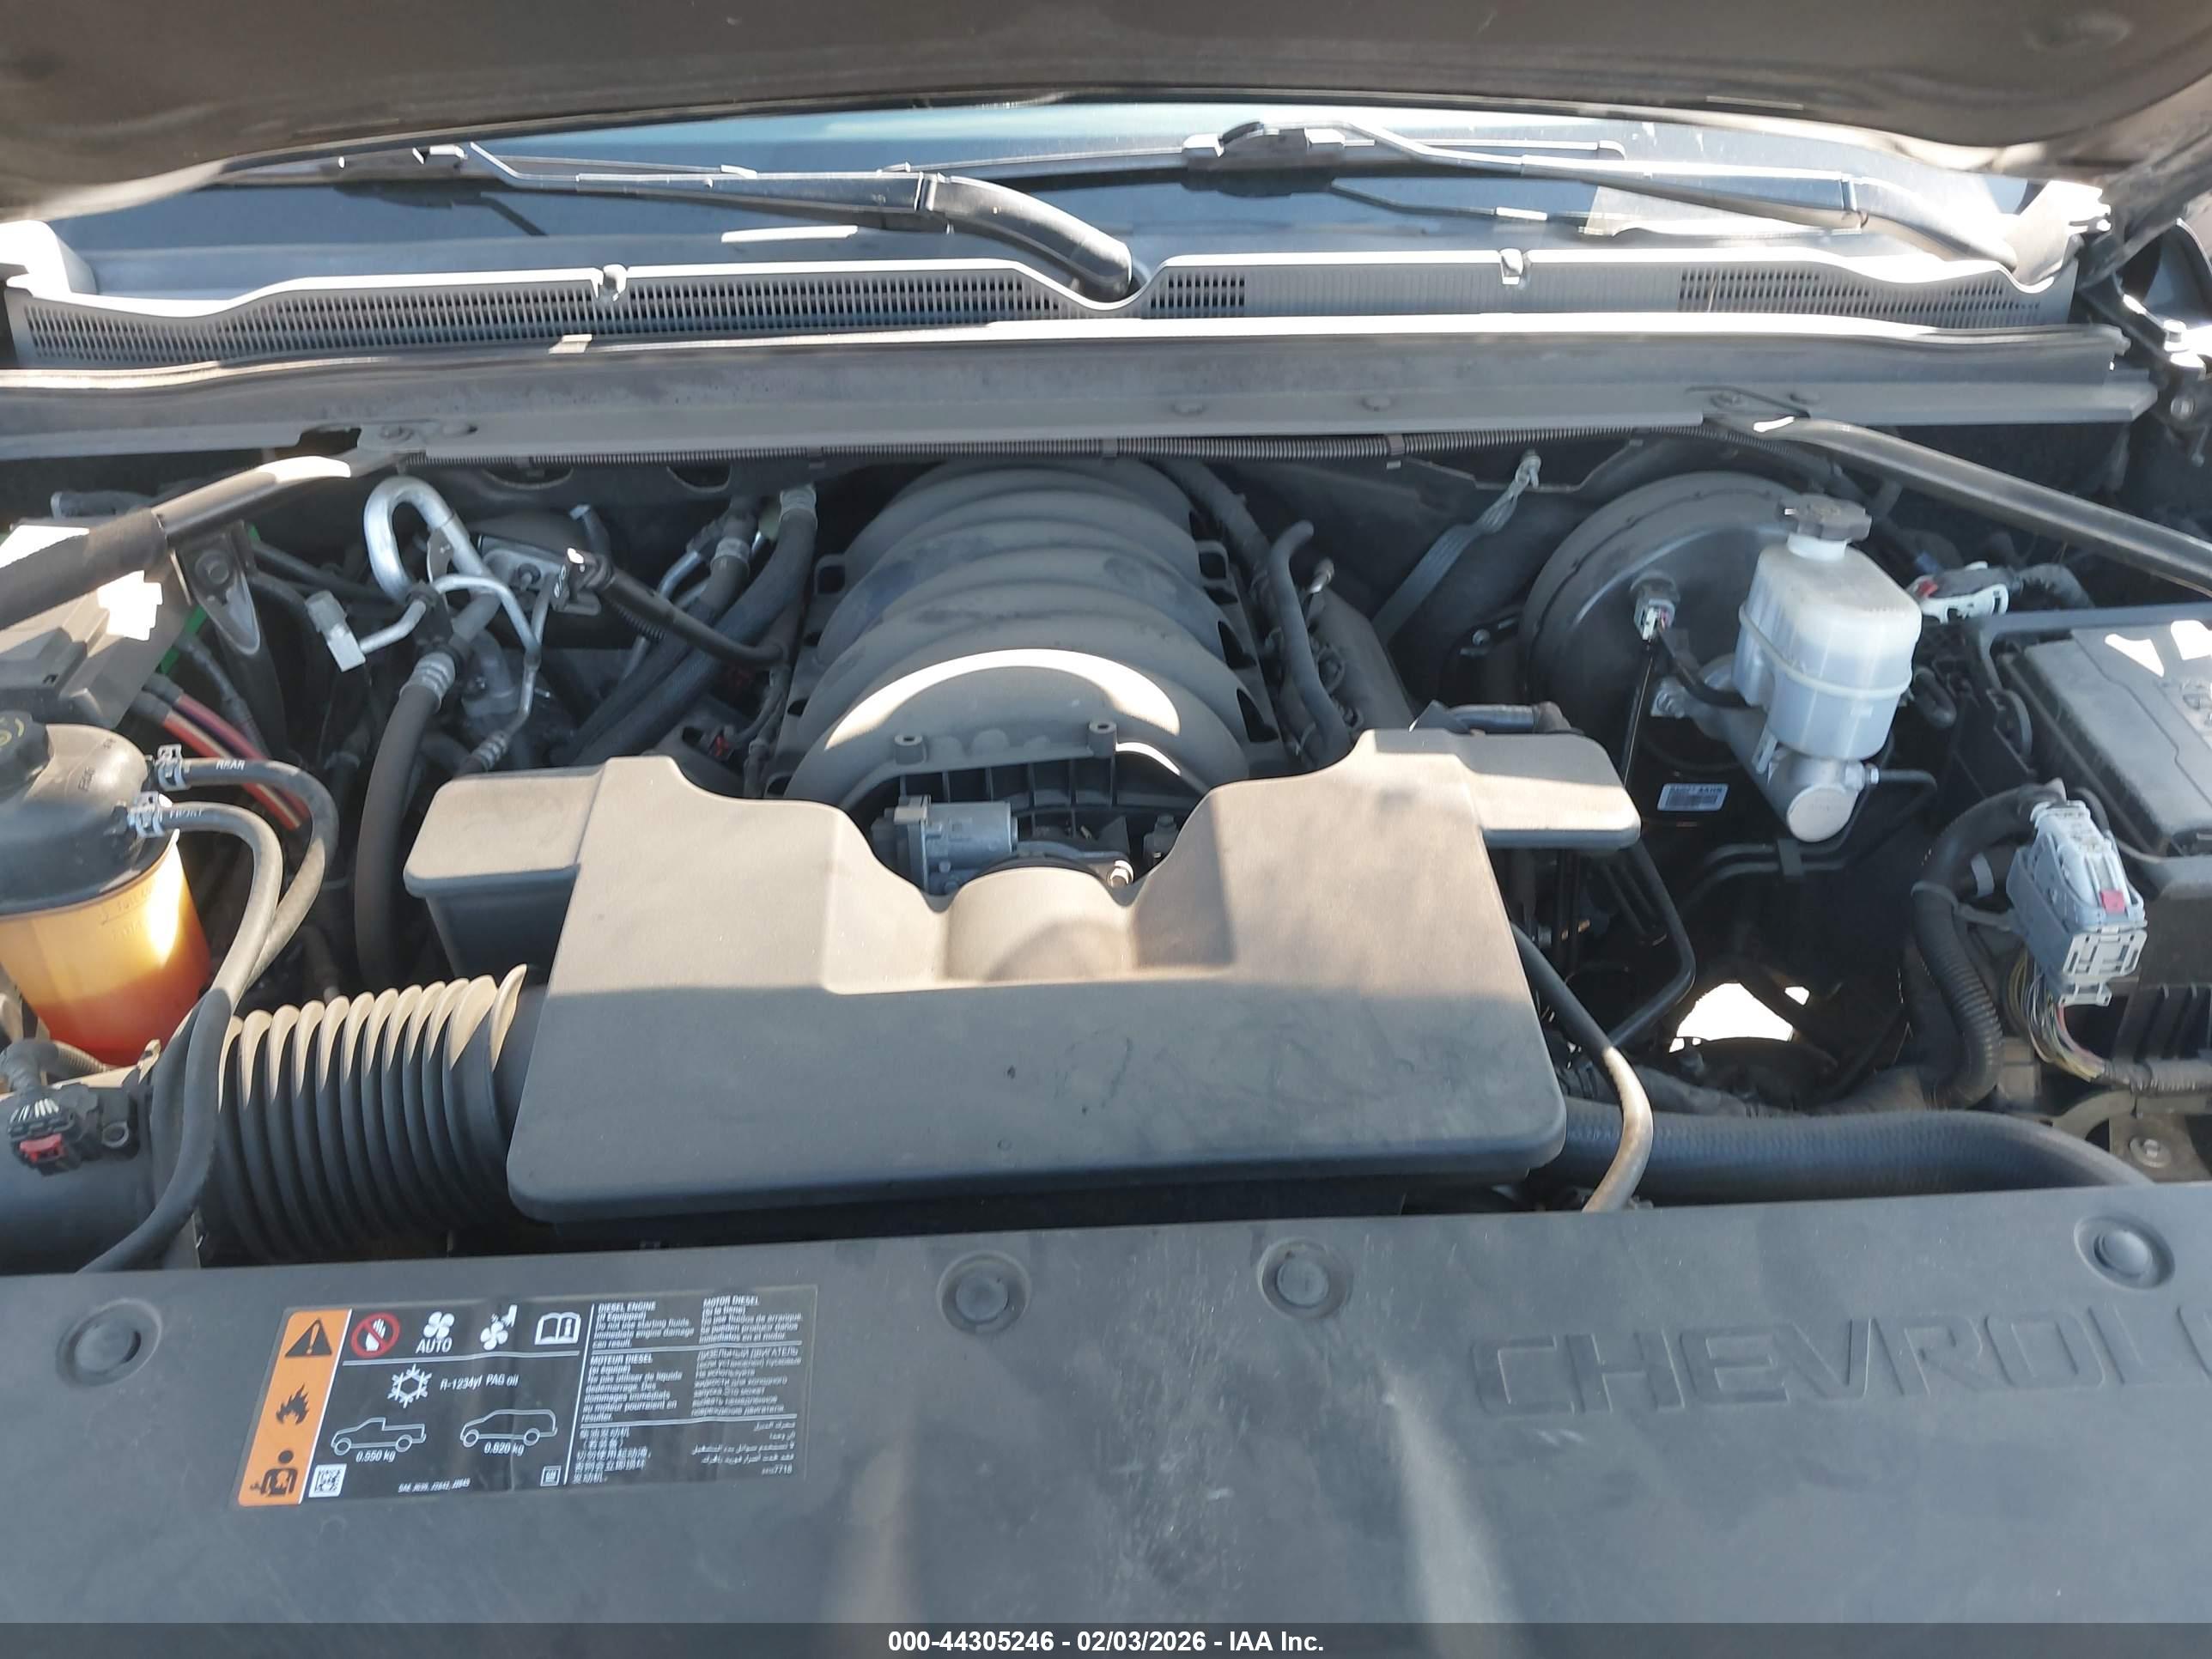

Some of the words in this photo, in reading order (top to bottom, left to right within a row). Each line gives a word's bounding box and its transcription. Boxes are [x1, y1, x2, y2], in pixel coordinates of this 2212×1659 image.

[216, 759, 246, 771] REAR
[599, 1303, 624, 1312] DIESEL
[627, 1301, 656, 1311] ENGINE
[703, 1296, 730, 1307] MOTOR
[732, 1295, 758, 1305] DIESEL
[416, 1337, 453, 1353] AUTO
[591, 1354, 624, 1365] MOTEUR
[625, 1353, 653, 1364] DIESEL
[486, 1374, 505, 1386] PAG
[507, 1374, 520, 1386] oil
[512, 1443, 525, 1456] kg
[383, 1449, 396, 1463] kg
